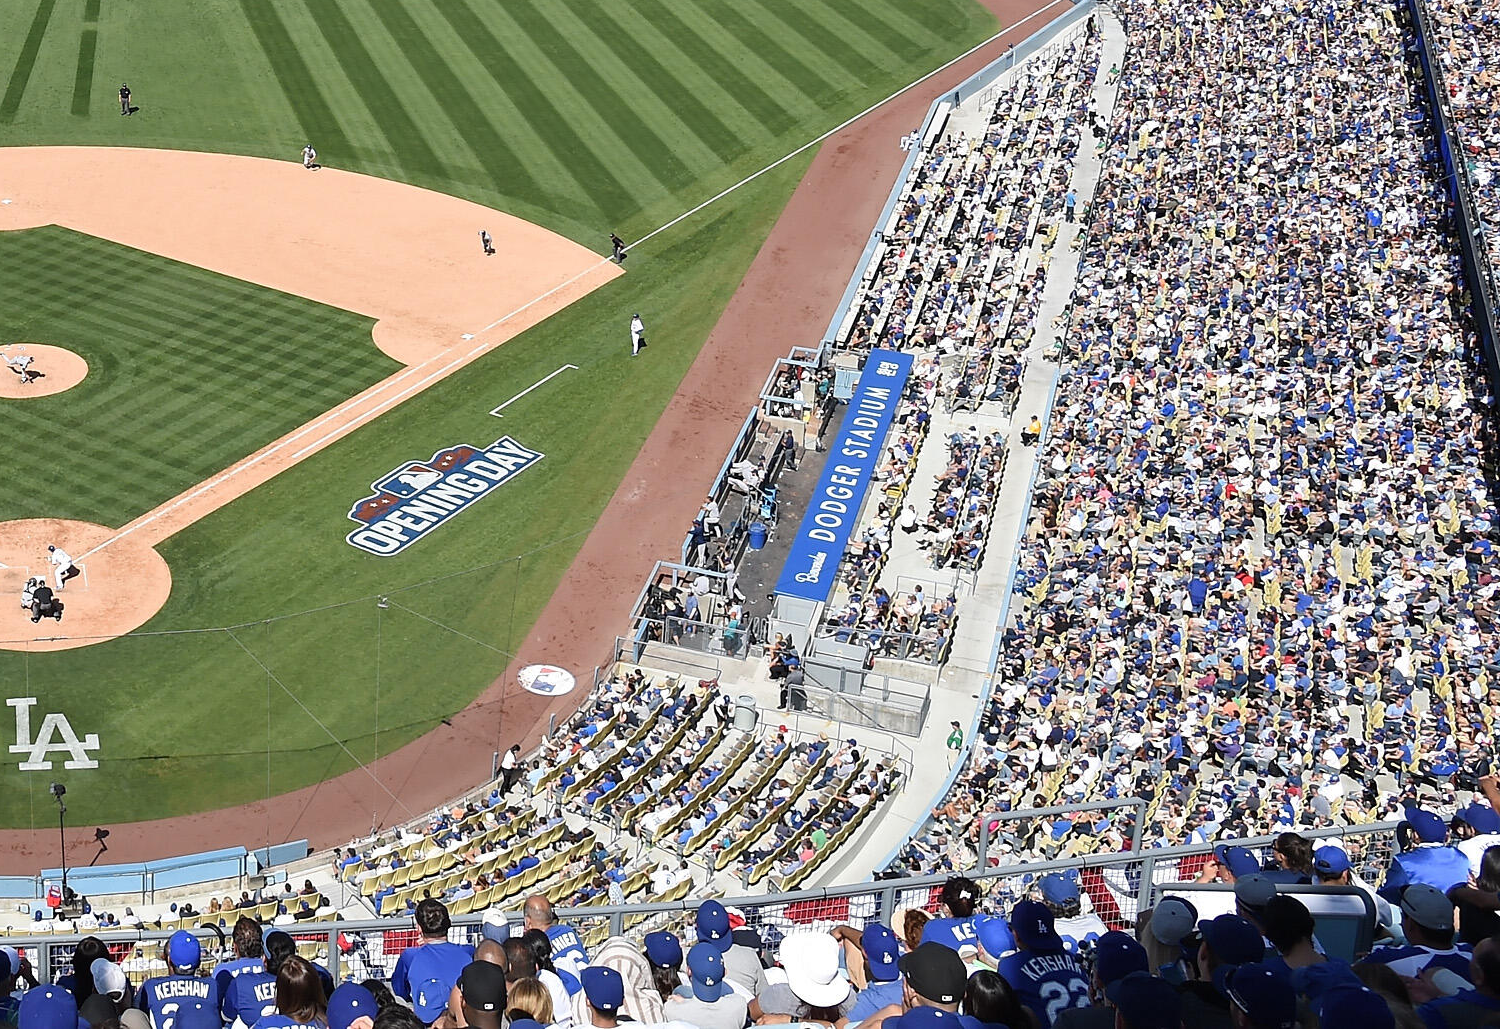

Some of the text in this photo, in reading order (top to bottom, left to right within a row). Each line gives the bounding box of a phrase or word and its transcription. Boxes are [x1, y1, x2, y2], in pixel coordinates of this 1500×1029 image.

[353, 441, 535, 553] OPENING DAY
[808, 466, 861, 543] DODGER
[841, 387, 891, 459] STADIUM
[6, 697, 100, 771] LA
[1038, 920, 1048, 934] LA
[154, 980, 210, 1001] KERSHAW
